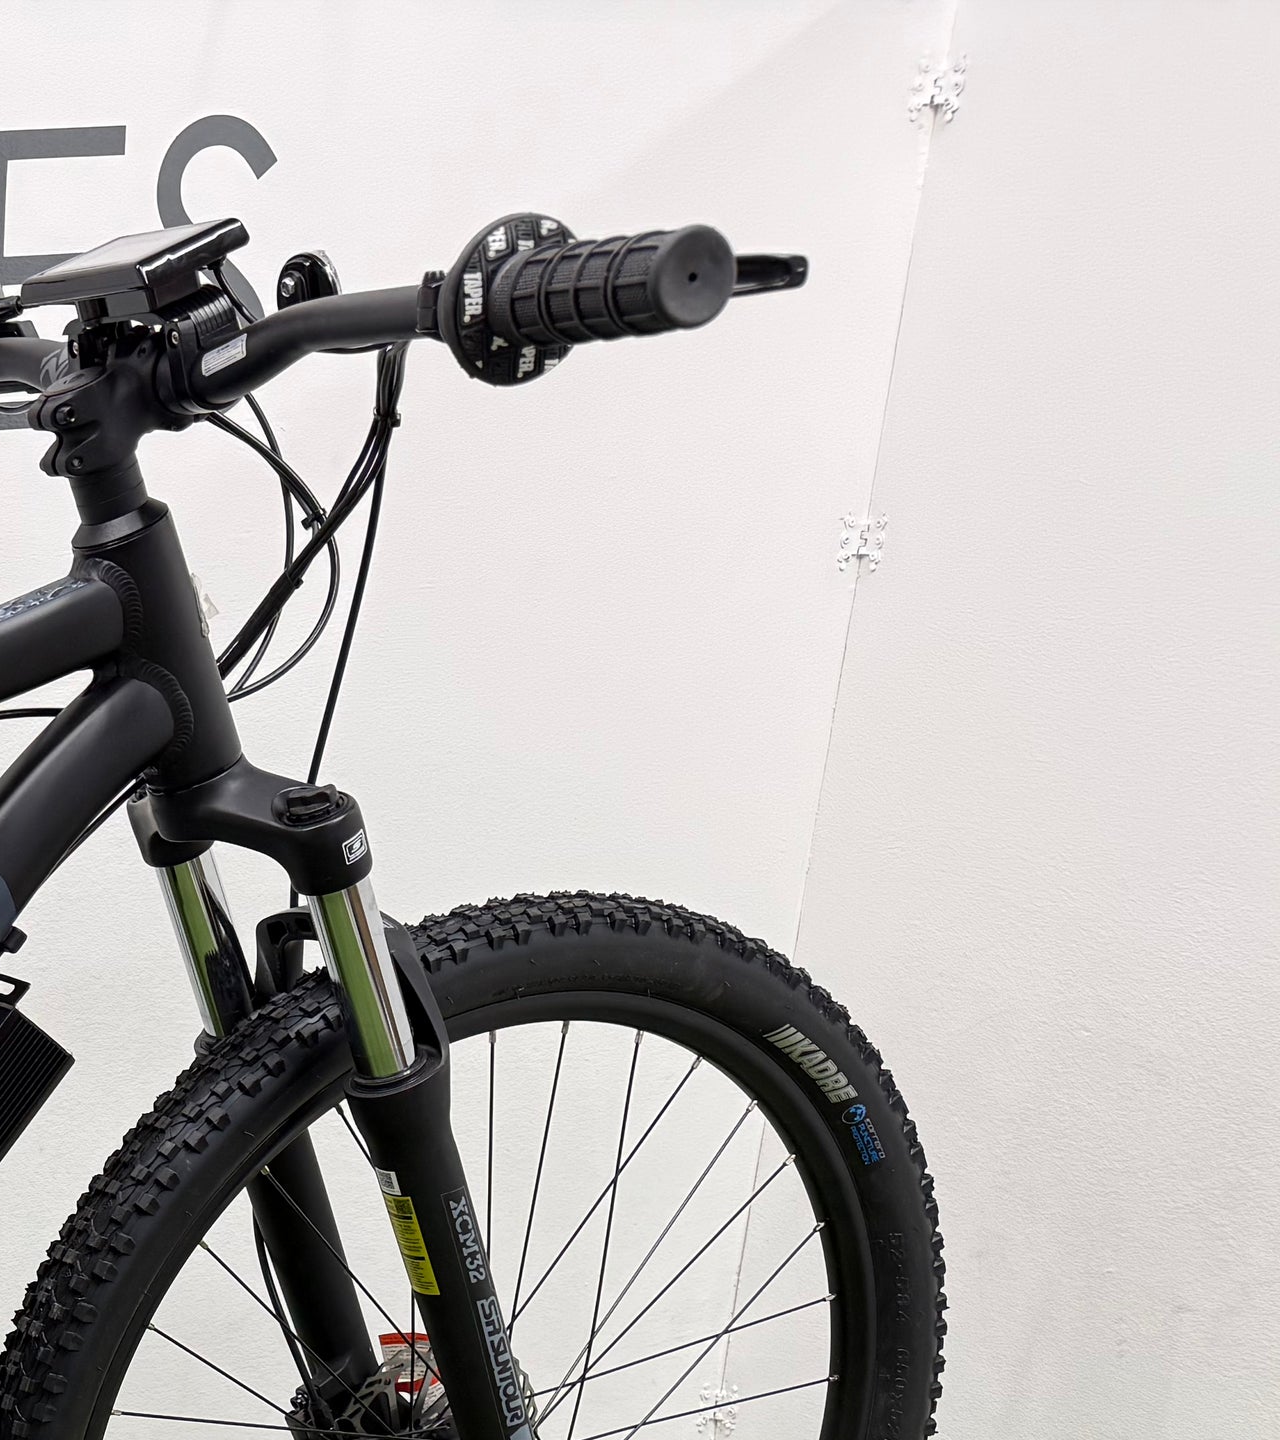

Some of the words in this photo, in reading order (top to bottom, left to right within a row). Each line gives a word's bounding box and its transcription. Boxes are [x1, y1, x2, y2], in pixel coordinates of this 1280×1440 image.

[788, 1038, 859, 1104] KADRE
[449, 1196, 486, 1284] XCM32
[490, 1336, 525, 1427] SUNTOUR
